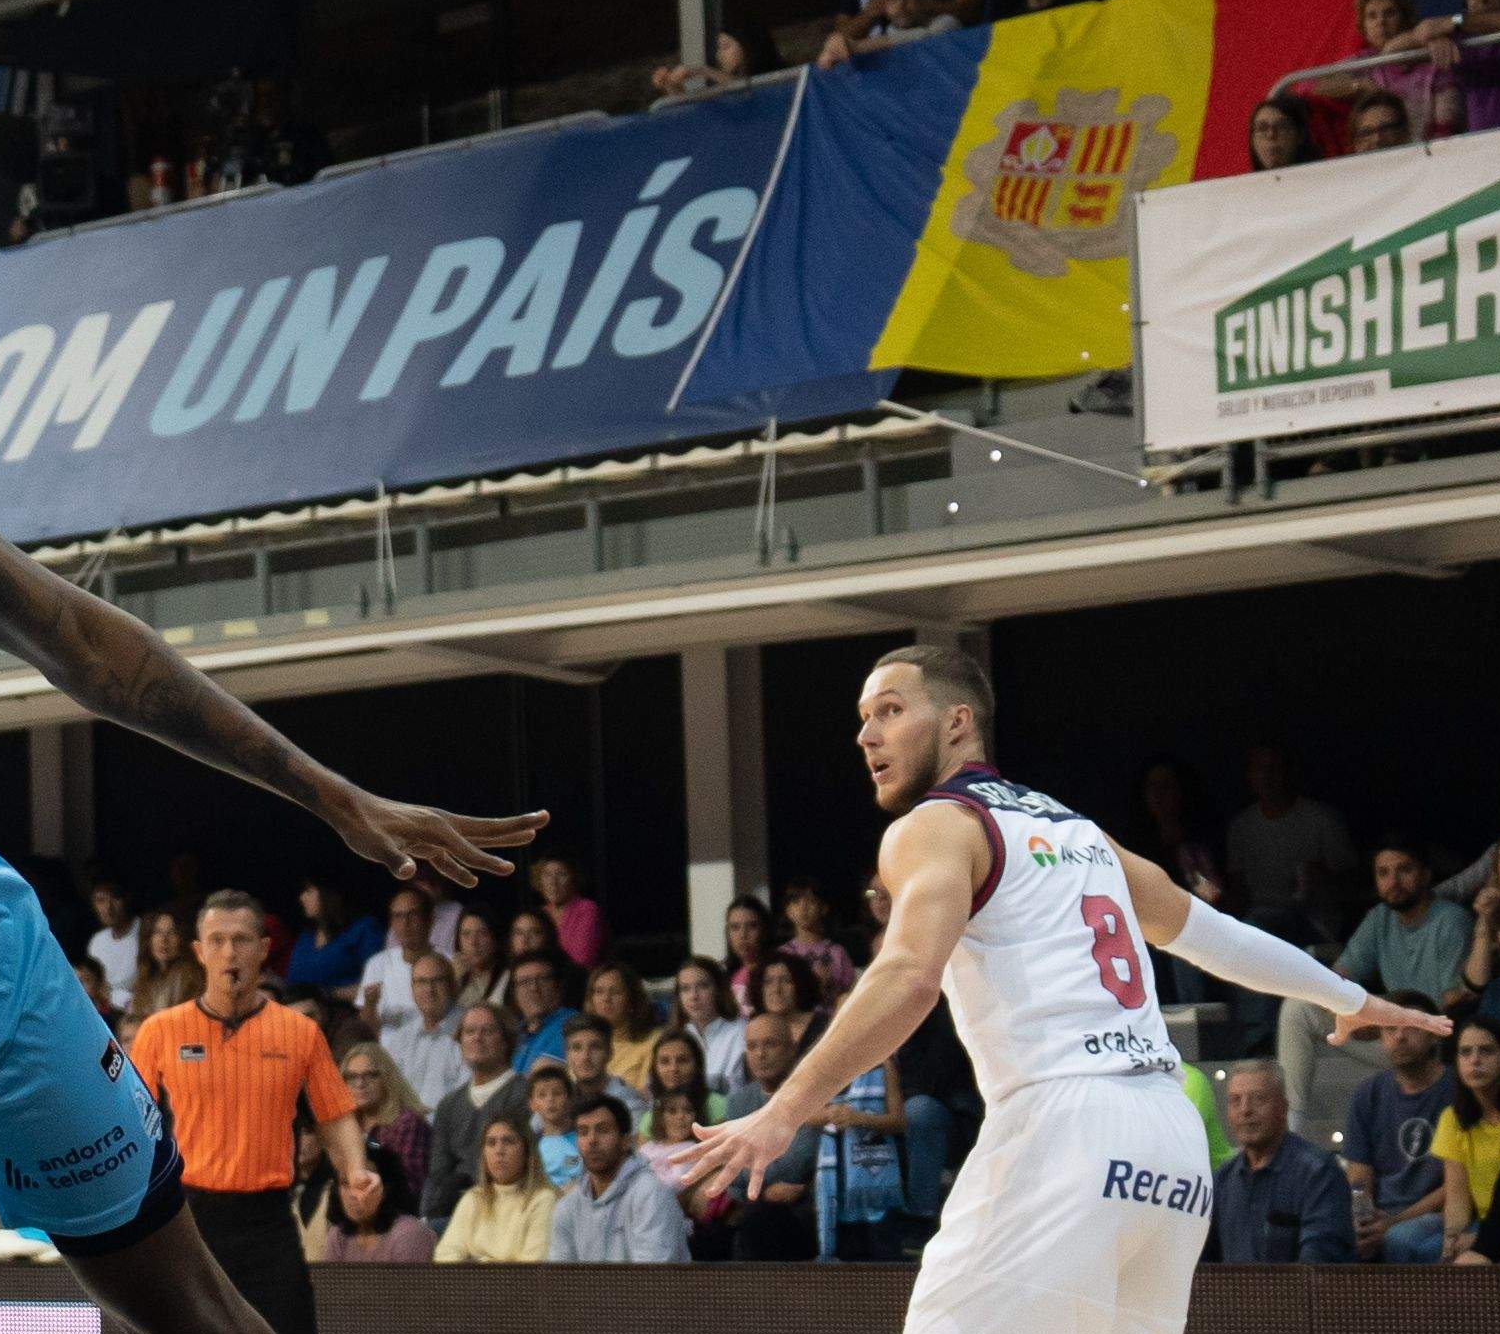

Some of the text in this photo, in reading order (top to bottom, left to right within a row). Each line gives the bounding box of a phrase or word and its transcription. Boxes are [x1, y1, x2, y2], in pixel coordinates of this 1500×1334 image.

[145, 253, 391, 439] UN
[359, 156, 760, 402] PAÍS
[1081, 893, 1148, 1010] 8
[39, 1124, 126, 1172] andorra
[46, 1141, 139, 1189] telecom
[1102, 1159, 1213, 1218] Recalv
